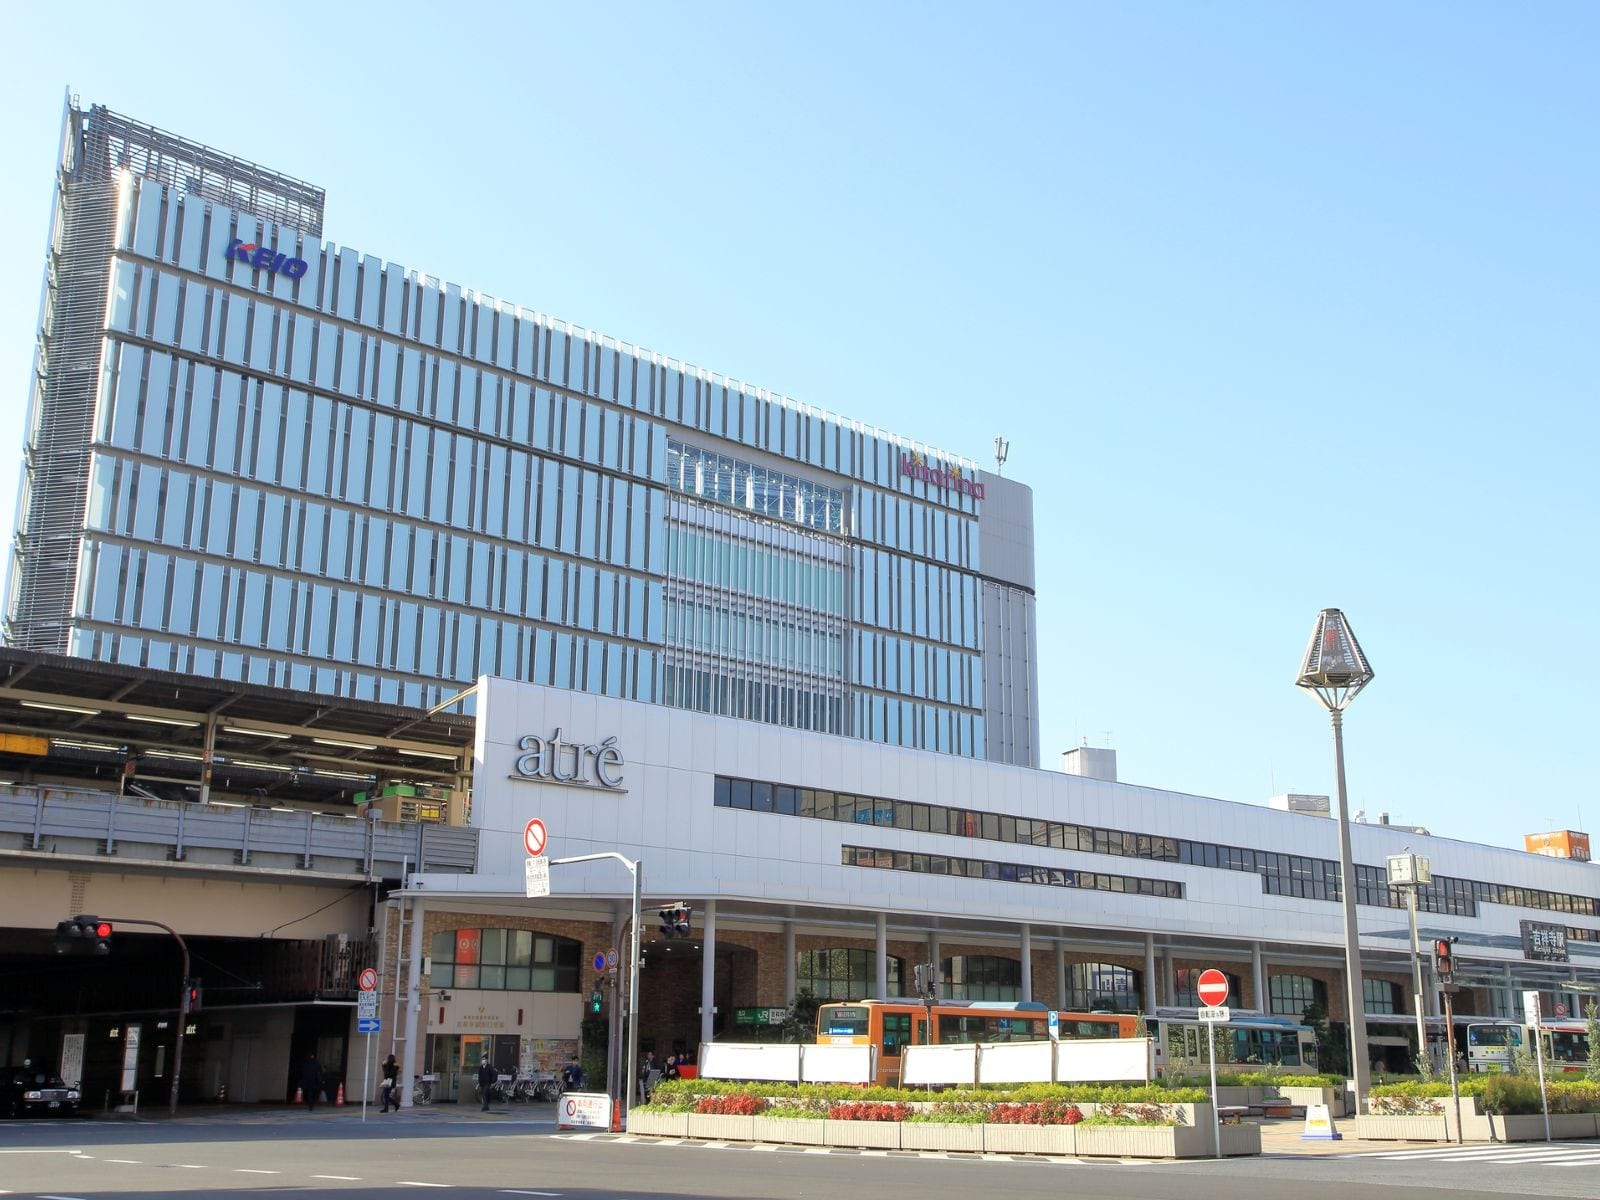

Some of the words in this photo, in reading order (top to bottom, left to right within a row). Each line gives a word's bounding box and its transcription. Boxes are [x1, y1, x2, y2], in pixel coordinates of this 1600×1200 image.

[226, 239, 308, 280] KEIO
[902, 452, 984, 499] kirarina
[517, 728, 624, 788] atré
[1532, 929, 1565, 947] 吉祥寺駅
[758, 1010, 769, 1019] JR
[1050, 1012, 1056, 1025] P
